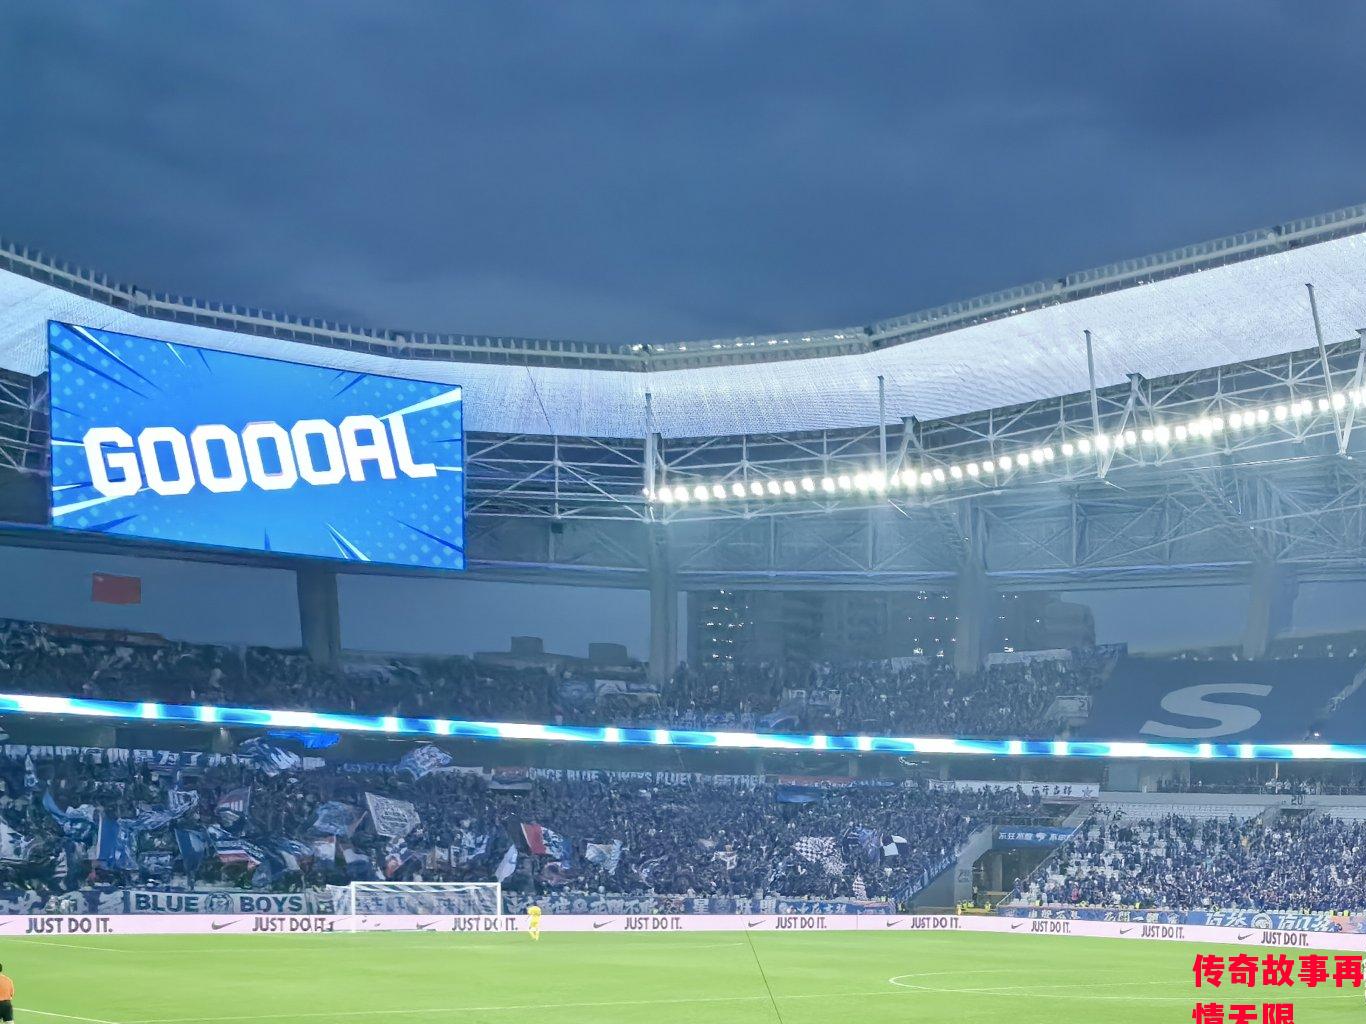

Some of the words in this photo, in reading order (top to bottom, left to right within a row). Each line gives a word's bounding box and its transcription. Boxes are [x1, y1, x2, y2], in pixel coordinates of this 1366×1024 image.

[83, 414, 437, 497] GOOOOAL
[135, 894, 199, 912] BLUE
[240, 896, 303, 912] BOYS
[26, 918, 63, 933] JUST
[68, 918, 91, 933] DO
[96, 918, 113, 933] IT.
[252, 917, 285, 931] JUST
[290, 917, 310, 931] DO
[452, 918, 480, 931] JUST
[505, 918, 518, 931] IT.
[624, 918, 649, 930] JUST
[653, 918, 668, 930] DO
[670, 918, 682, 930] IT.
[775, 917, 798, 929] JUST
[801, 917, 814, 929] DO
[816, 917, 827, 929] IT.
[911, 918, 930, 929] JUST
[932, 917, 948, 929] DO
[950, 917, 961, 929] IT.
[1031, 921, 1048, 932] JUST
[1050, 922, 1062, 933] DO
[1062, 922, 1071, 933] IT.
[1141, 925, 1161, 938] JUST
[1161, 926, 1174, 938] DO
[1175, 927, 1185, 939] IT.
[1260, 931, 1281, 945] JUST
[1284, 932, 1297, 945] DO
[1299, 933, 1309, 946] IT.
